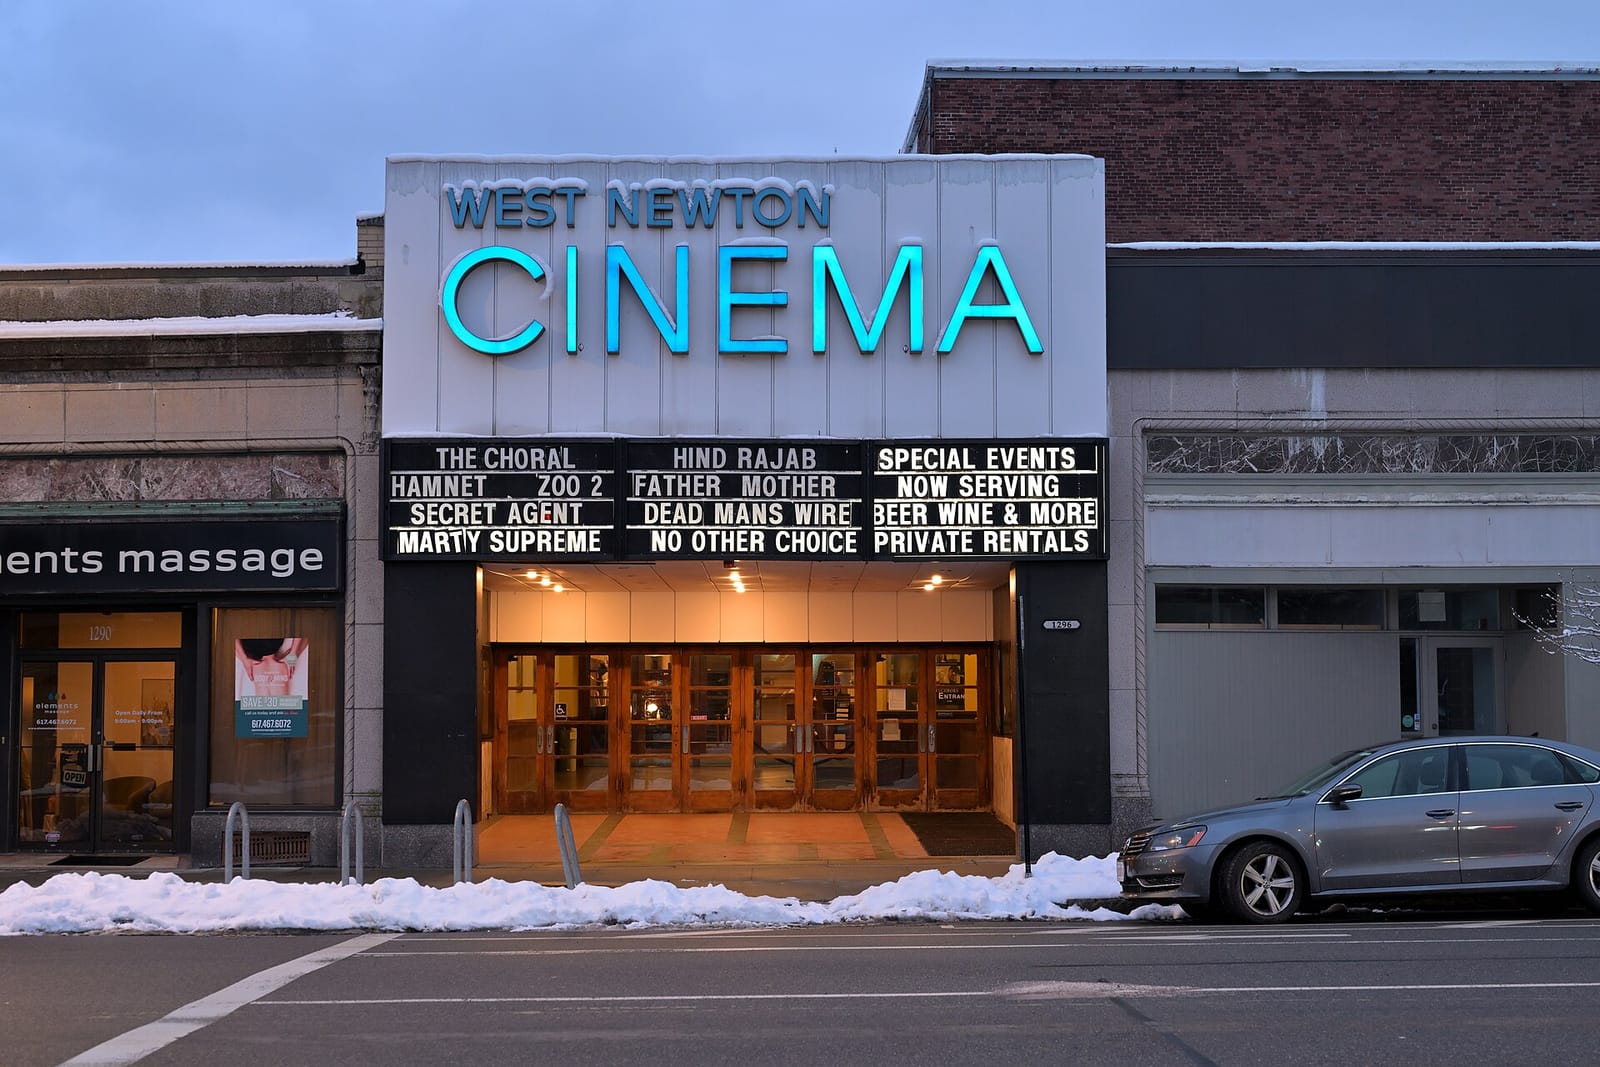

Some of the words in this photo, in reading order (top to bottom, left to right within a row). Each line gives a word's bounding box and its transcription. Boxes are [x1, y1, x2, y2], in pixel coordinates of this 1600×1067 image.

[447, 187, 586, 229] WEST
[608, 187, 831, 229] NEWTON
[442, 245, 1044, 355] CINEMA
[436, 447, 477, 469] THE
[484, 447, 576, 469] CHORAL
[673, 447, 727, 469] HIND
[737, 447, 817, 470] RAJAB
[879, 447, 976, 470] SPECIAL
[987, 447, 1076, 470] EVENTS
[391, 475, 487, 497] HAMNET
[537, 475, 581, 497] ZOO
[591, 475, 603, 497] 2
[634, 474, 721, 497] FATHER
[741, 475, 836, 497] MOTHER
[898, 475, 948, 497] NOW
[959, 475, 1060, 498] SERVING
[410, 502, 497, 526] SECRET
[507, 502, 583, 525] AGENT
[644, 502, 704, 525] DEAD
[714, 503, 784, 525] MANS
[794, 503, 850, 525] WIRE
[874, 503, 928, 526] BEER
[938, 503, 993, 525] WINE
[1003, 503, 1019, 525] &
[1030, 503, 1096, 525] MORE
[399, 530, 481, 553] MARTY
[490, 530, 601, 553] SUPREME
[651, 530, 682, 552] NO
[691, 530, 765, 552] OTHER
[775, 530, 857, 553] CHOICE
[875, 531, 973, 553] PRIVATE
[983, 530, 1089, 553] RENTALS
[0, 547, 103, 574] ents
[119, 548, 324, 577] massage
[90, 625, 112, 641] 1290
[1052, 621, 1072, 629] 1296
[35, 702, 79, 710] elements
[242, 696, 263, 708] SAVE
[251, 720, 292, 729] 617.467.6072
[65, 771, 85, 783] OPEN
